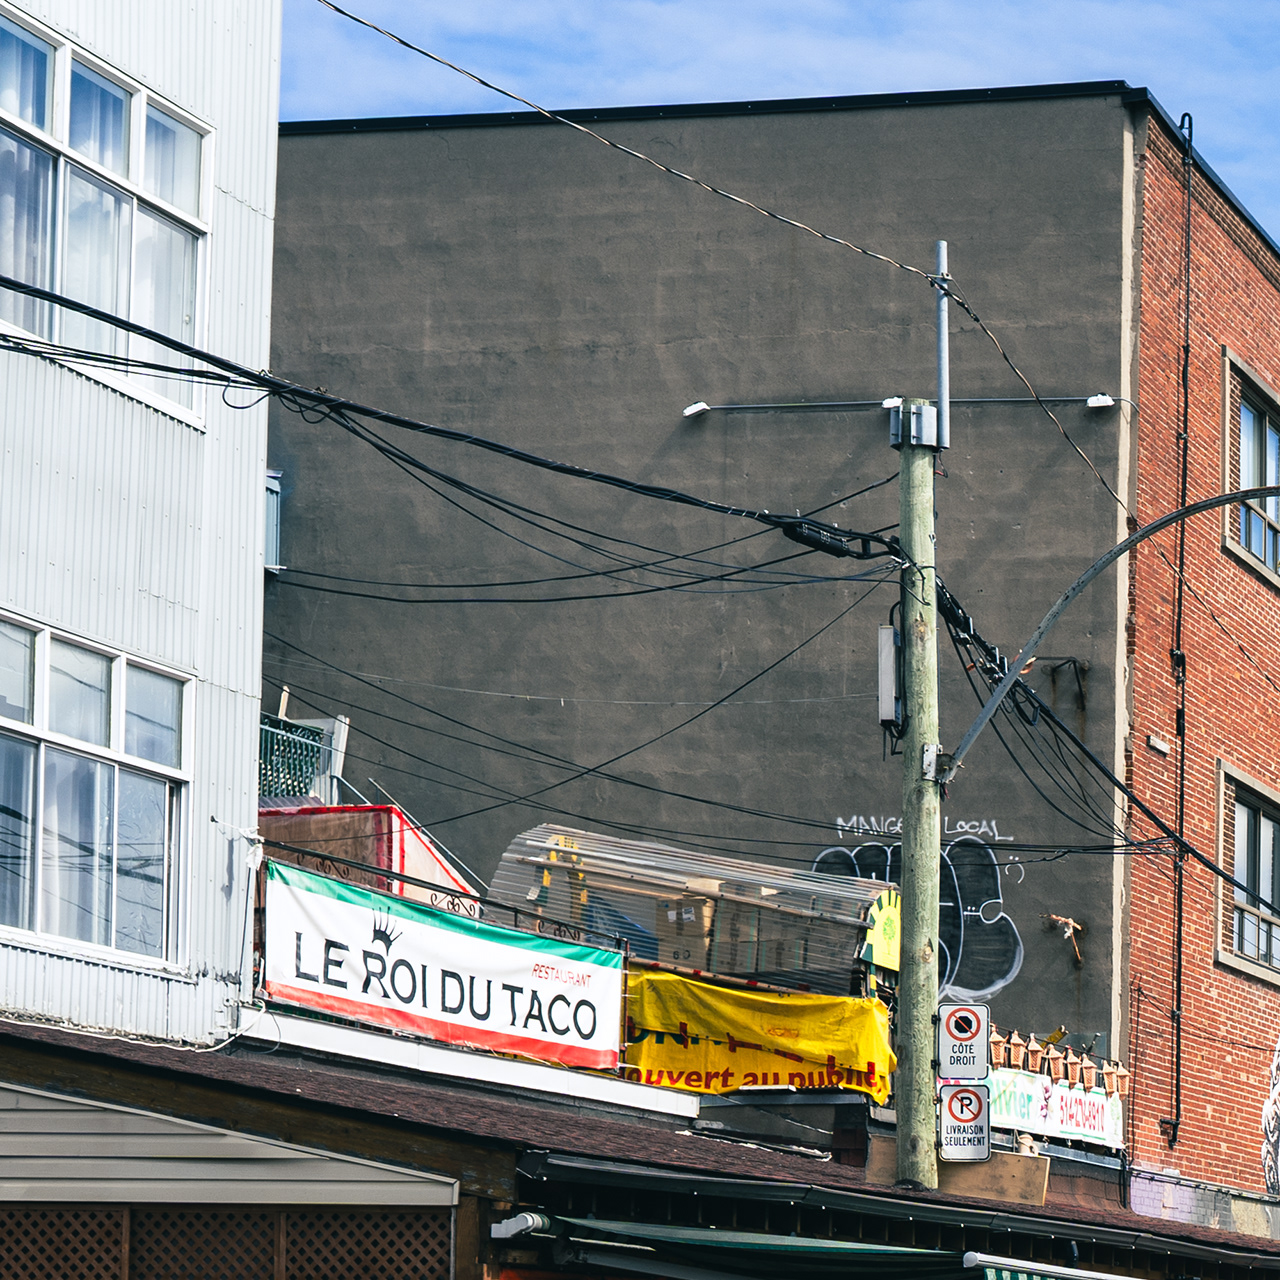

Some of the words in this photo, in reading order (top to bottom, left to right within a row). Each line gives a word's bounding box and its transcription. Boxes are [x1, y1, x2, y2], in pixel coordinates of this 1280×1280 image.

[944, 816, 1013, 841] LOCAL
[531, 962, 592, 989] RESTAURANT
[294, 931, 350, 990] LE
[361, 949, 428, 1009] ROI
[440, 969, 493, 1022] DU
[502, 982, 597, 1041] TACO
[951, 1041, 974, 1053] CÔTÉ
[949, 1055, 976, 1066] DROIT
[945, 1124, 984, 1135] LIVRAISON
[944, 1136, 985, 1147] SEULEMENT
